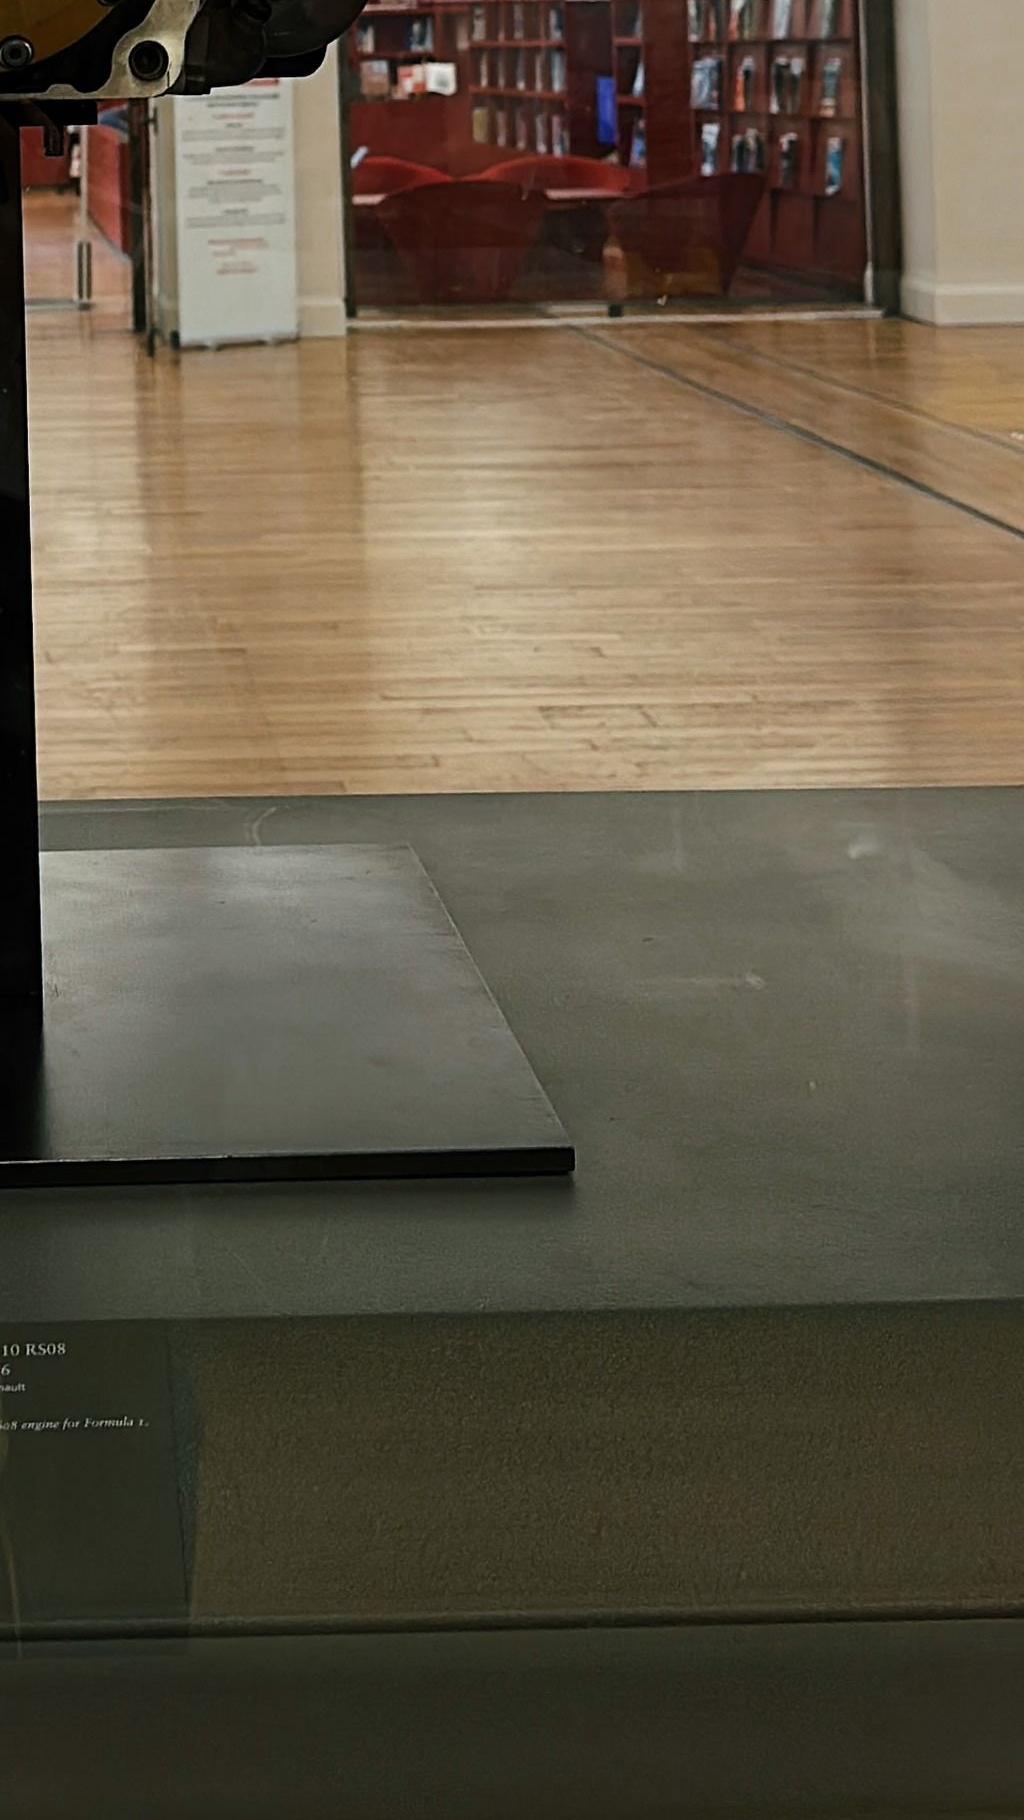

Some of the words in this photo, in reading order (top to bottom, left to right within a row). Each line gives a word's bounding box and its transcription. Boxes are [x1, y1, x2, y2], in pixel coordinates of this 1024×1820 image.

[25, 1342, 67, 1356] RS08
[21, 1420, 60, 1432] engine
[62, 1417, 81, 1431] for
[84, 1415, 133, 1429] Formula
